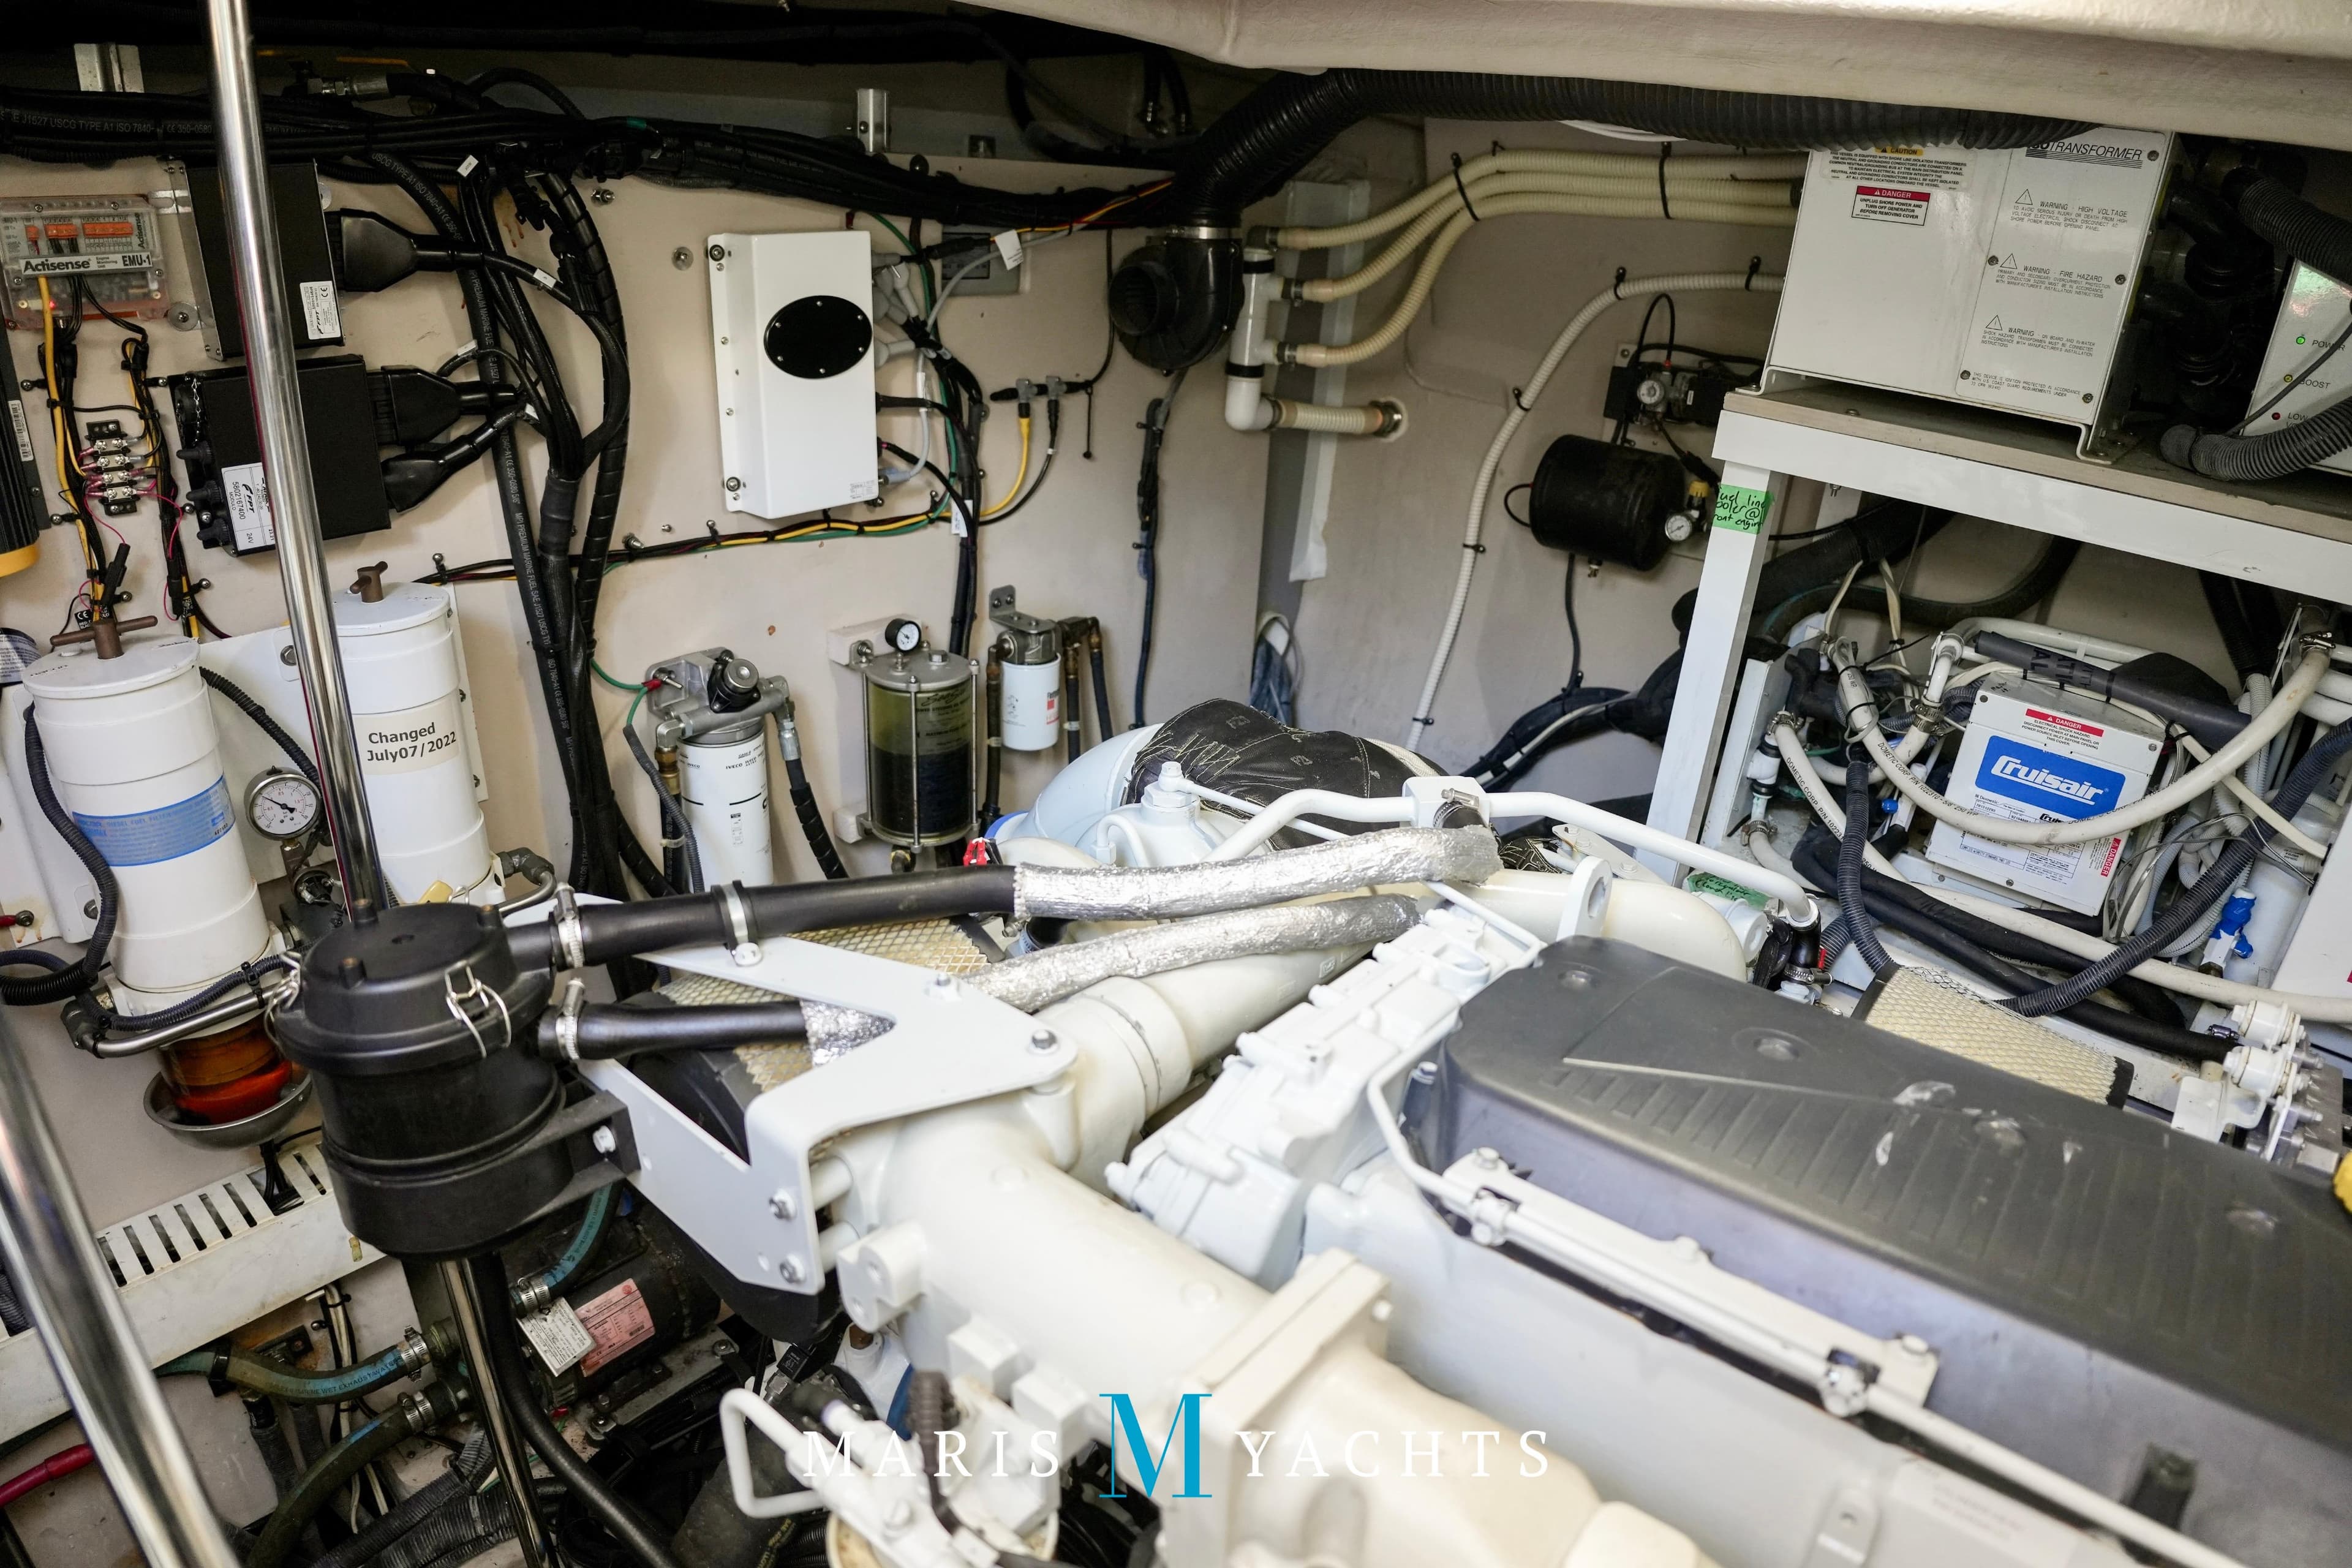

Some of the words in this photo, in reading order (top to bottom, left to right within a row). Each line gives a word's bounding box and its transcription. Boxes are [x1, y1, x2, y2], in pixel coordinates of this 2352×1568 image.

[50, 118, 76, 129] USCG
[80, 121, 101, 130] TYPE
[104, 123, 113, 131] A1
[116, 123, 130, 132] ISO
[372, 153, 392, 167] USCG
[391, 162, 408, 179] TYPE
[415, 181, 426, 194] ISO
[1882, 190, 1911, 198] DANGER
[2040, 201, 2068, 210] WARNING
[2098, 208, 2128, 217] VOLTAGE
[24, 258, 90, 273] Actisense
[2024, 265, 2050, 275] WARNING
[2077, 273, 2103, 282] HAZARD
[2045, 285, 2072, 294] INSTALLATION
[2054, 276, 2082, 285] OVERCURRENT
[2086, 281, 2110, 289] PROTECTION
[472, 279, 488, 309] PREMIUM
[480, 308, 492, 330] MARINE
[485, 328, 495, 347] FUE
[2008, 328, 2034, 337] WARNING
[2018, 336, 2046, 344] TRANSFORMER
[2065, 348, 2092, 356] INSTALLATION
[2312, 339, 2345, 352] POWR
[2022, 385, 2051, 394] REQUIREMENTS
[2299, 379, 2331, 389] BOOST
[2288, 413, 2308, 421] LOW
[233, 481, 246, 520] 5802167400
[246, 494, 255, 513] FPT
[517, 524, 529, 552] PREMIUM
[522, 552, 534, 576] MARINE
[528, 575, 537, 590] FUEL
[532, 590, 540, 602] SAE
[538, 619, 548, 635] USCG
[2023, 721, 2049, 731] DISCONNECT
[2034, 720, 2059, 729] ELECTRICAL
[2056, 718, 2081, 729] DANGER
[369, 722, 435, 744] Changed
[2081, 740, 2098, 750] OPENING
[1878, 742, 1899, 764] DOMETIC
[1896, 763, 1910, 779] CORP.
[1910, 777, 1921, 786] P/N
[1918, 783, 1939, 800] 1022310
[1991, 755, 2104, 805] Cruisair
[1787, 757, 1805, 787] DOMETIC
[1818, 807, 1828, 820] P/N
[1828, 820, 1845, 840] 102231
[1980, 794, 1999, 804] Dometic
[2101, 848, 2117, 876] DANGER
